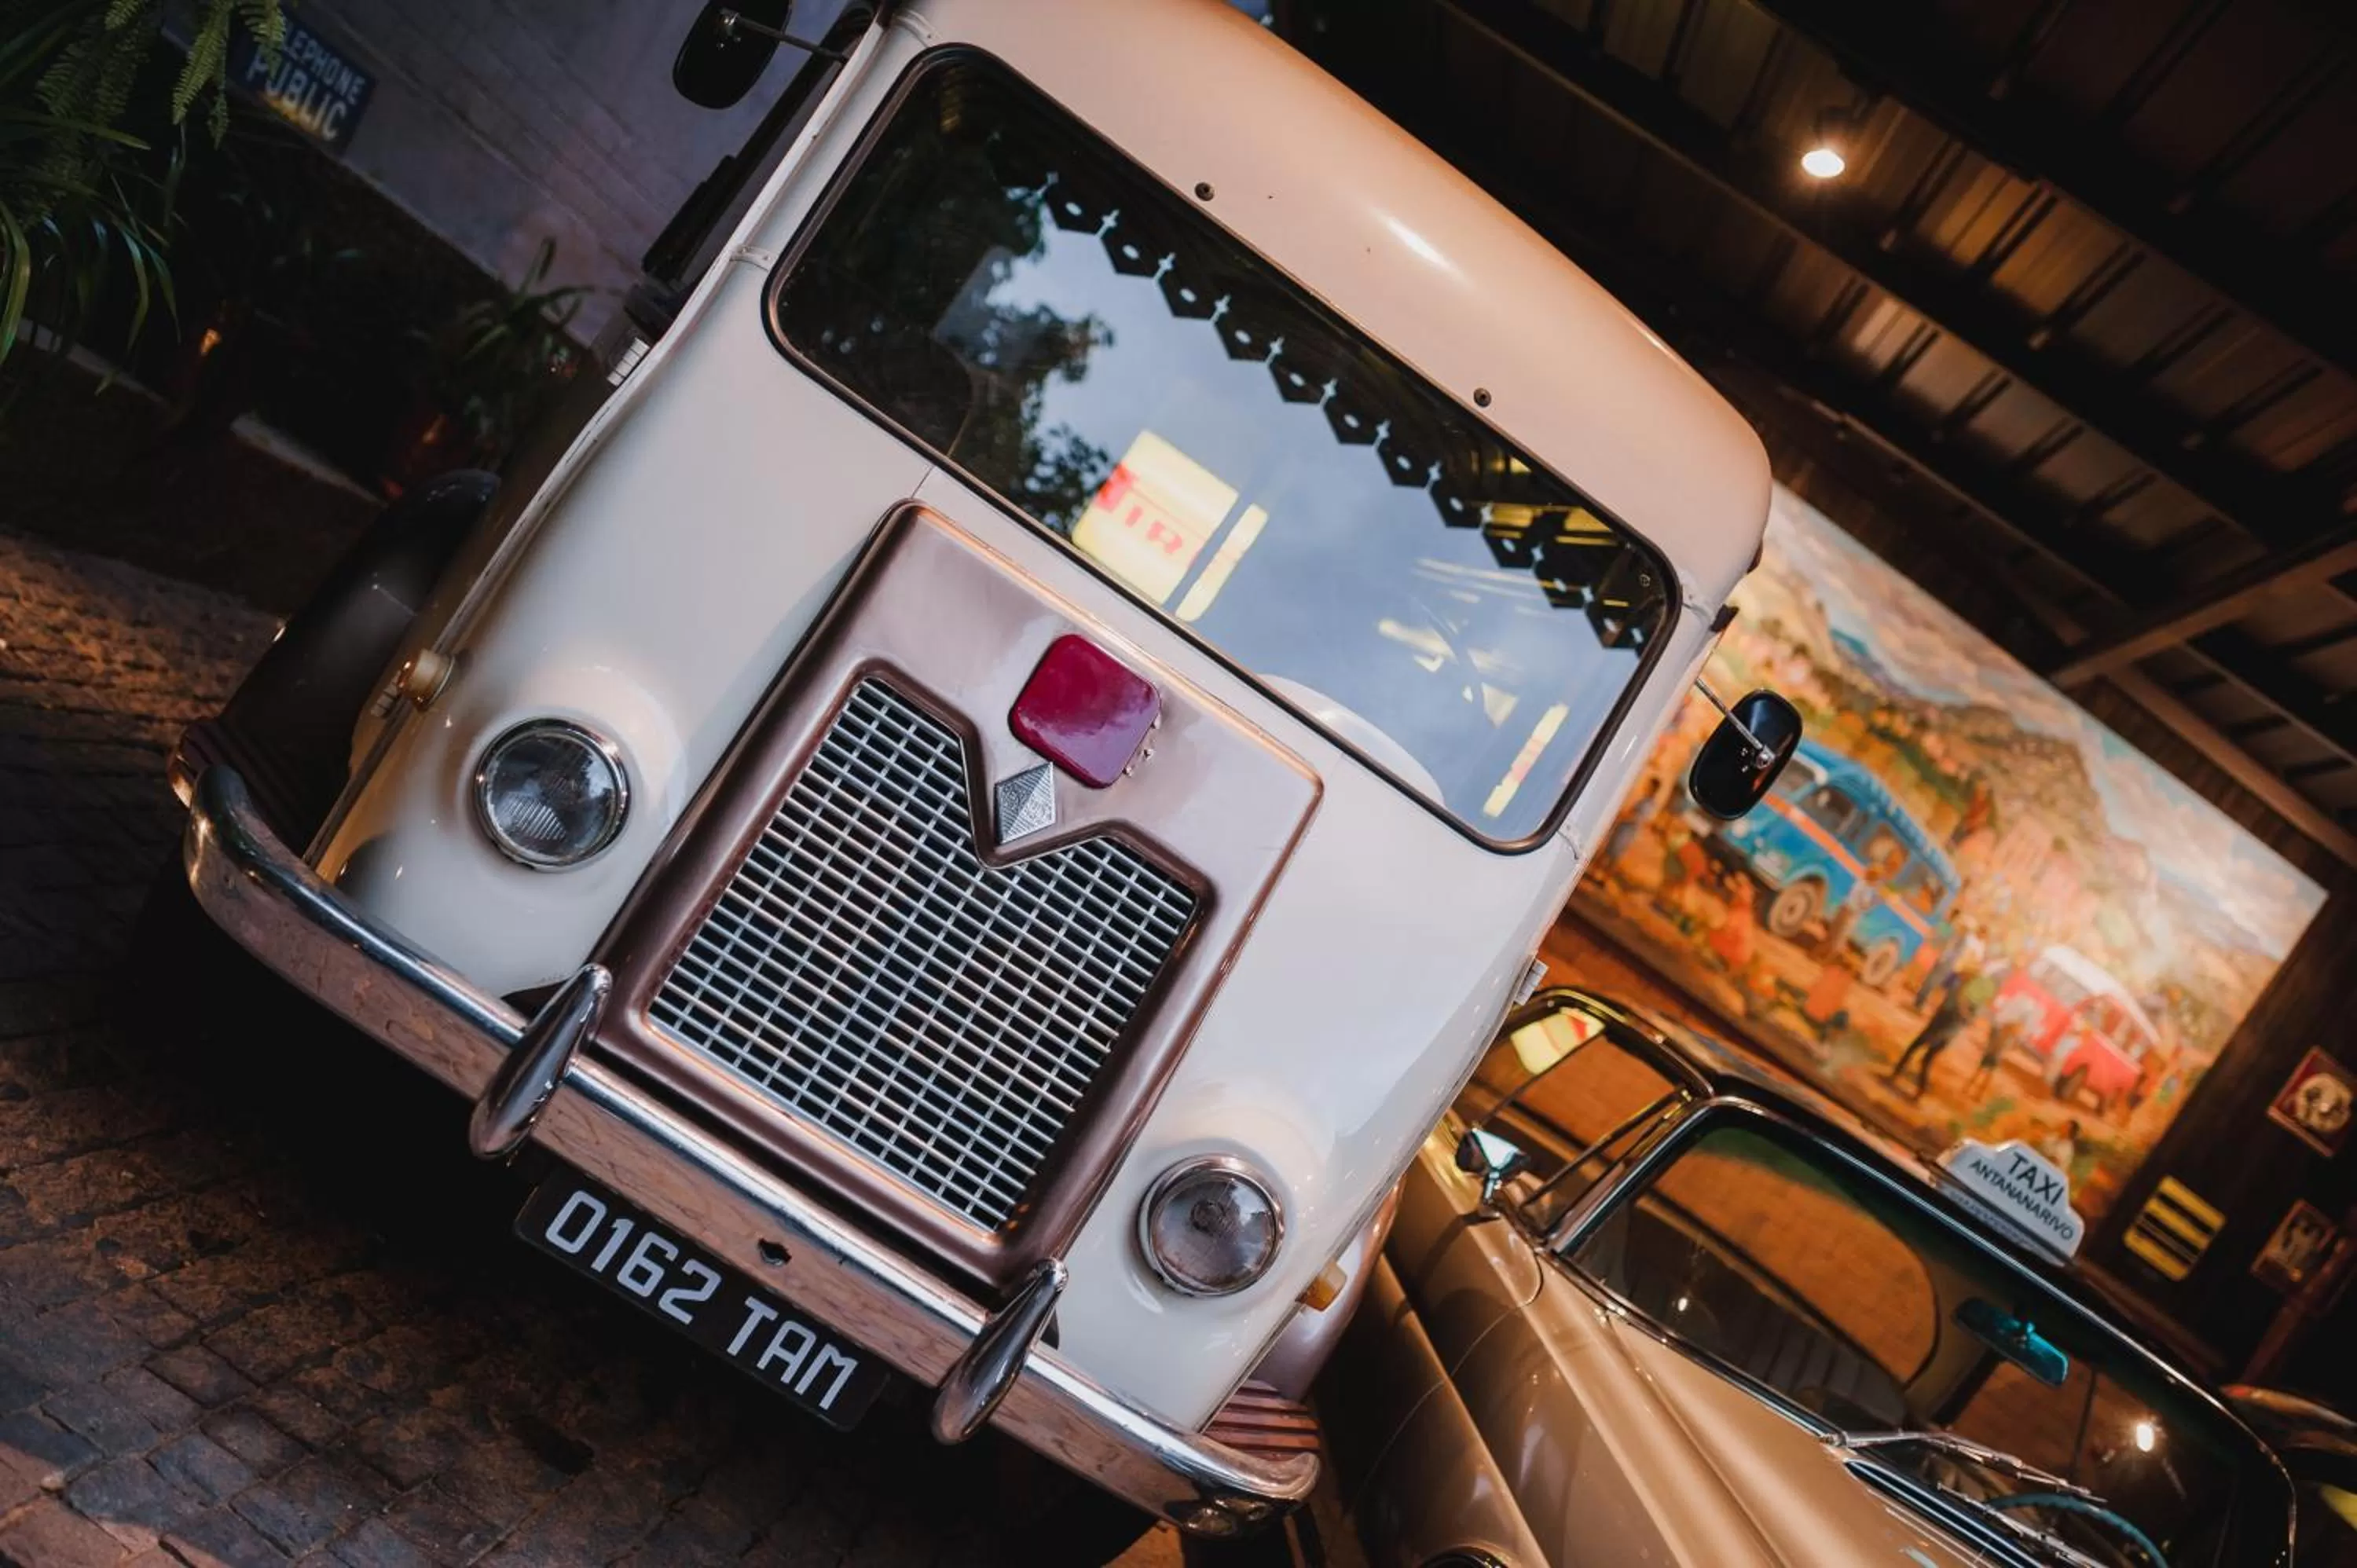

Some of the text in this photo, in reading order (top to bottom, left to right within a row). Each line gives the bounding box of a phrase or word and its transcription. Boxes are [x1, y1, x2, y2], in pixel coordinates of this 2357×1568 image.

[283, 19, 366, 104] LEPHONE
[1969, 1160, 2073, 1240] ANTANANARIVO
[2008, 1152, 2064, 1205] TAXI
[545, 1190, 858, 1411] 0162 TAM
